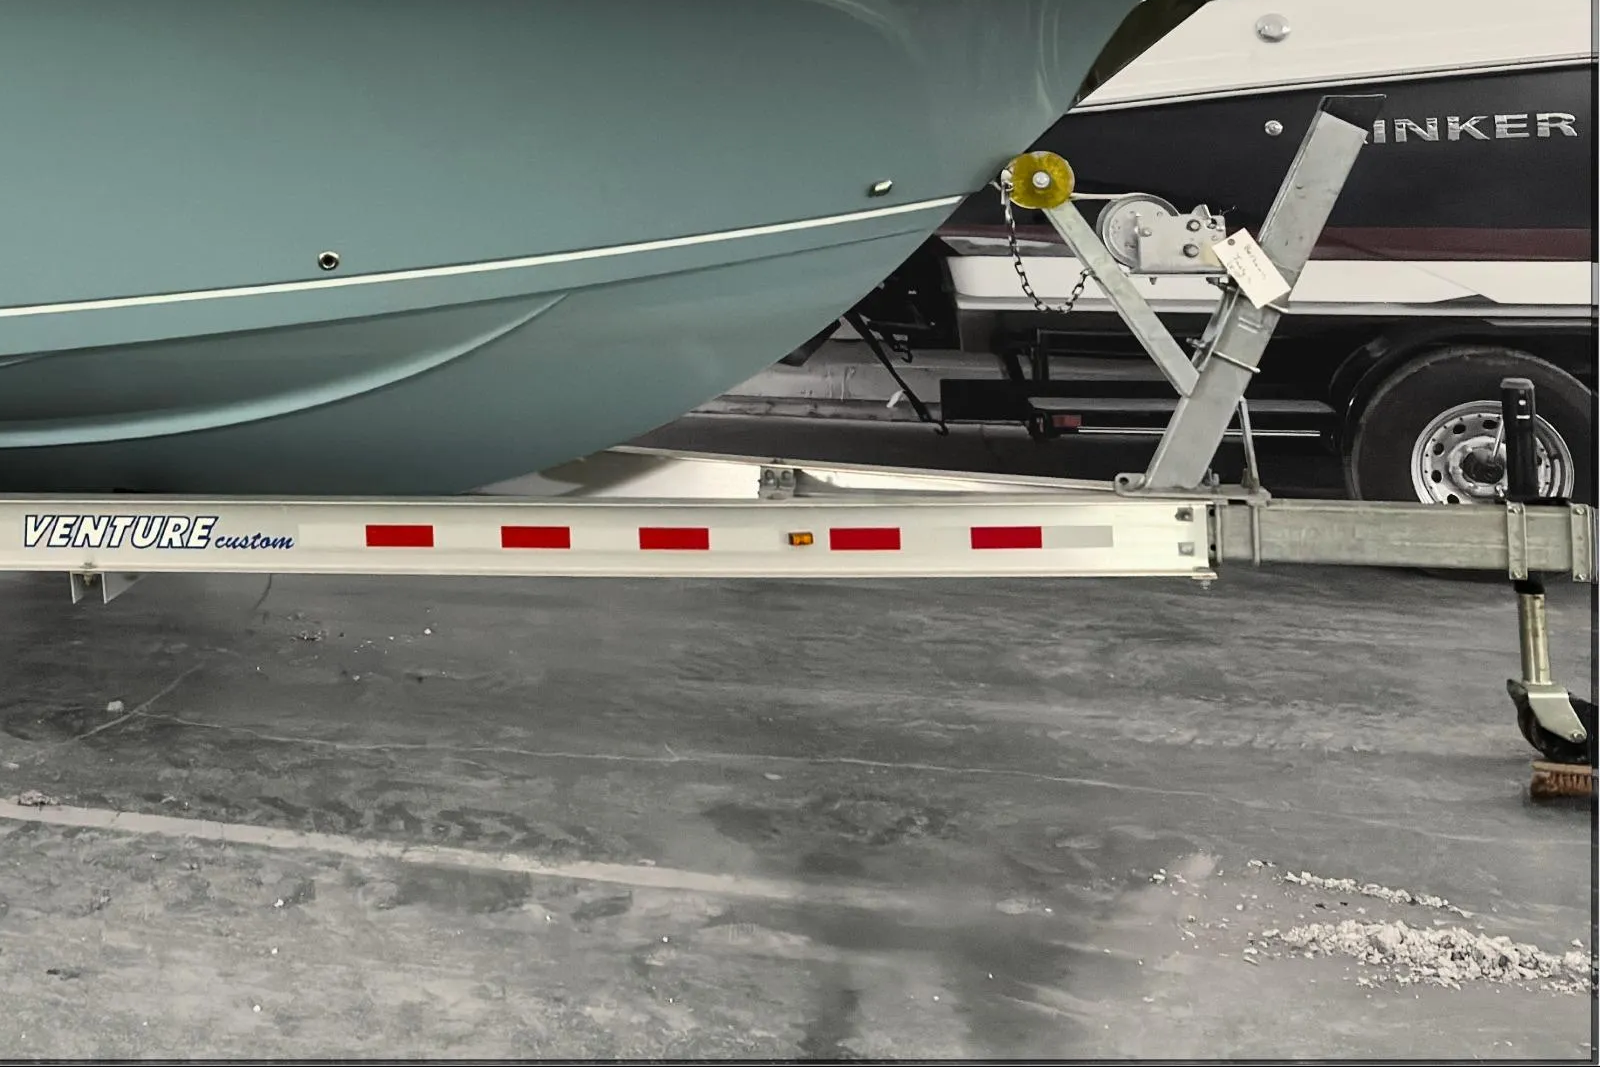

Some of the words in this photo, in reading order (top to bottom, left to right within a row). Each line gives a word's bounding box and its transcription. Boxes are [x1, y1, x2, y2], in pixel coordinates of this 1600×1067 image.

[1364, 112, 1578, 144] INKER
[24, 514, 219, 549] VENTURE
[214, 532, 294, 550] custom
